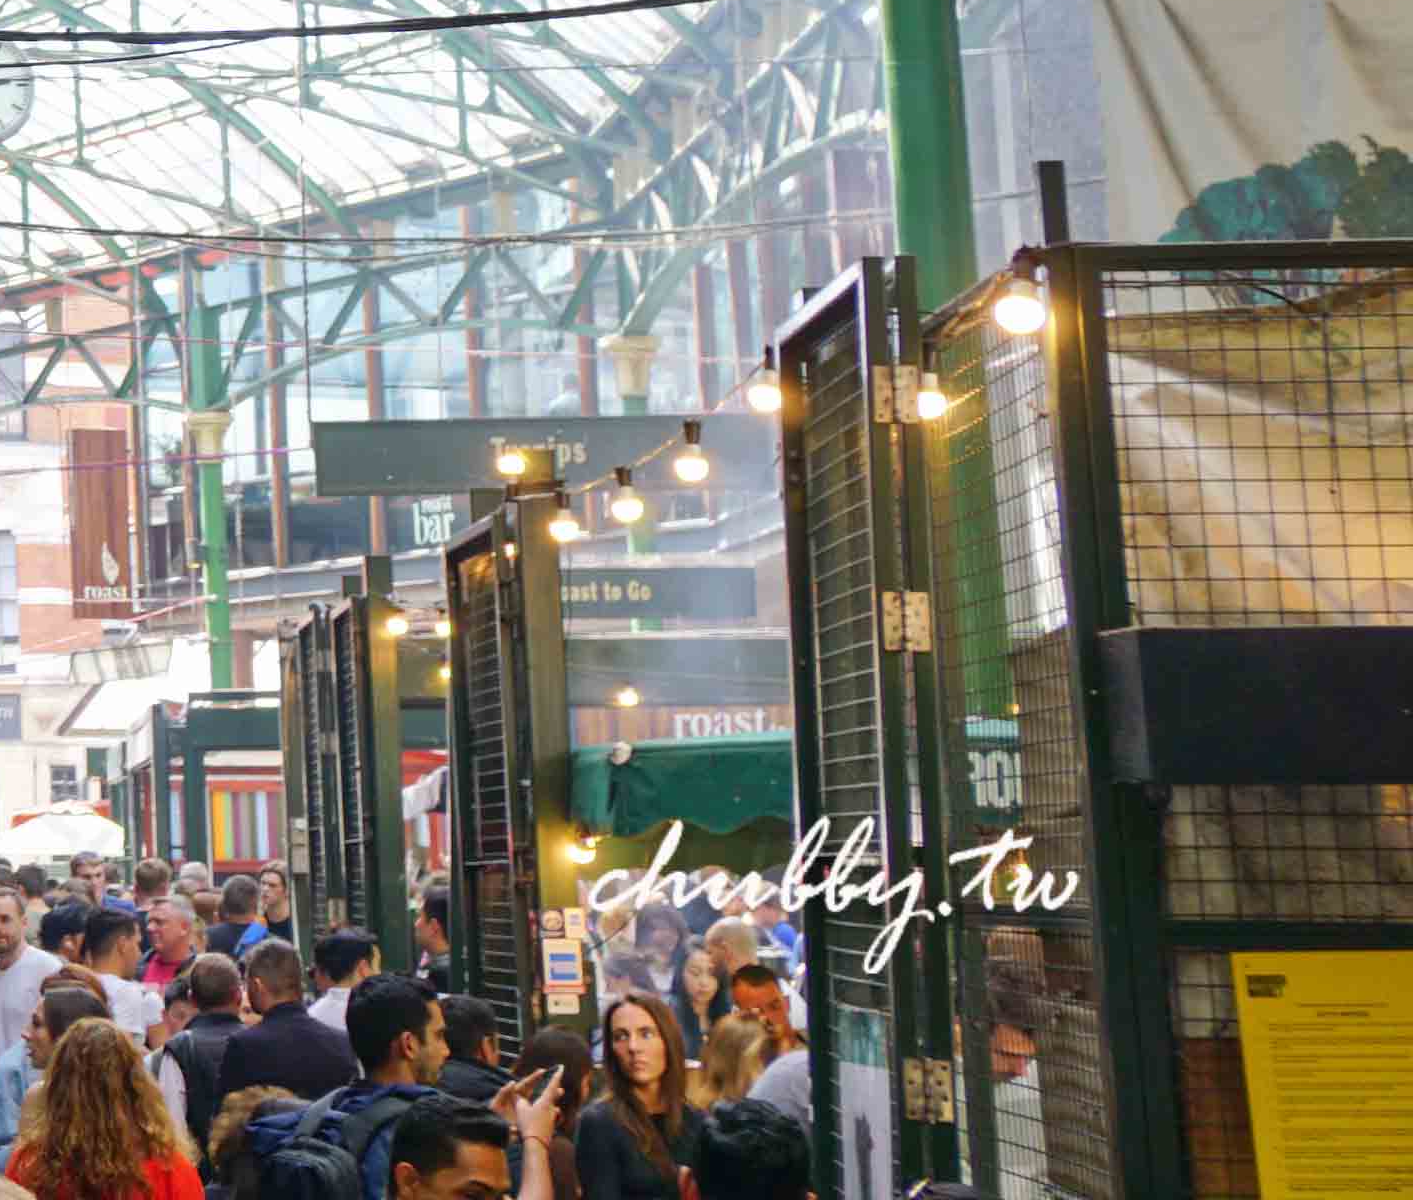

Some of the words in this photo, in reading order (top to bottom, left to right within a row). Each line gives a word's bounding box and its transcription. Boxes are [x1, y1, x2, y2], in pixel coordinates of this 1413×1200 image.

[413, 502, 455, 544] bar
[603, 581, 623, 602] to
[628, 579, 653, 603] Go
[675, 707, 767, 737] roast
